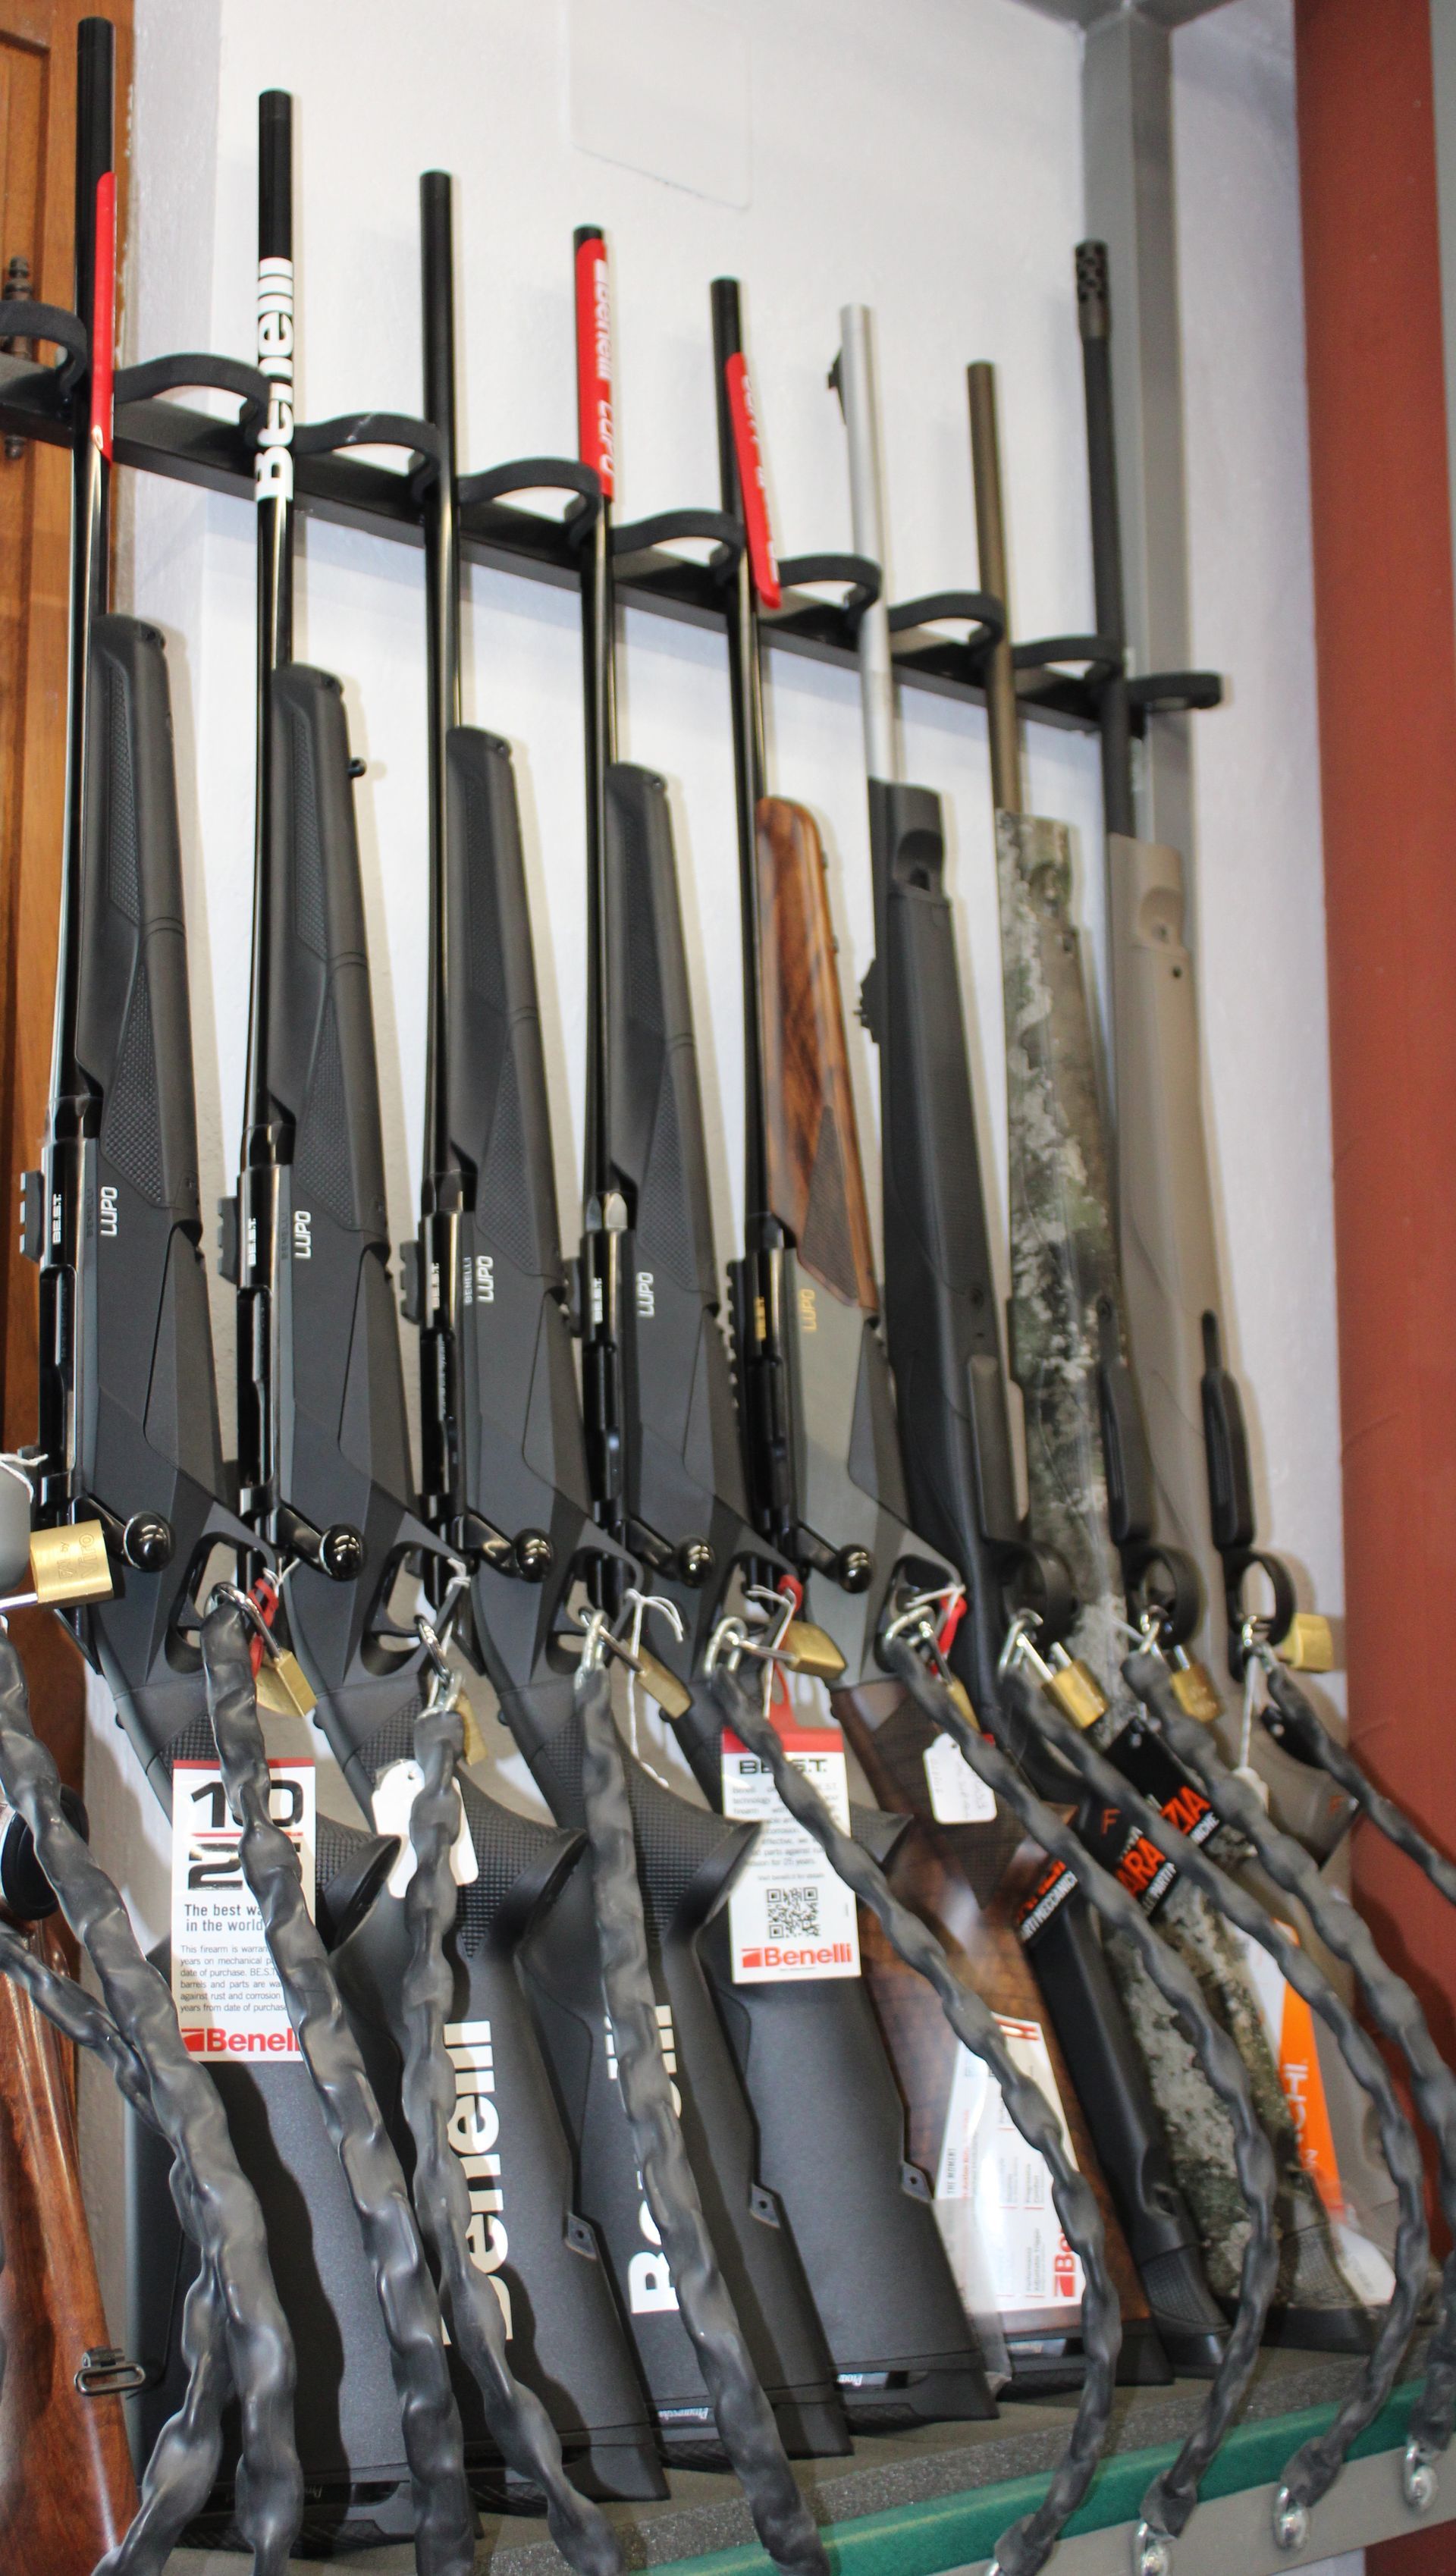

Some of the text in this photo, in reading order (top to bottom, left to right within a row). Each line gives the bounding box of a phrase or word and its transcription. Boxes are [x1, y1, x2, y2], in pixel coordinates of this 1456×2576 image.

[100, 1186, 118, 1237] LUPO
[294, 1210, 312, 1260] LUPO
[463, 1256, 472, 1306] BENELLI
[476, 1255, 494, 1303] LUPO
[636, 1272, 654, 1318] LUPO
[799, 1288, 817, 1332] LUPO
[188, 1843, 301, 1890] 2
[184, 1904, 207, 1916] The
[214, 1904, 240, 1916] best
[187, 1919, 263, 1931] in the world
[181, 1945, 197, 1953] This
[201, 1945, 228, 1953] firearm
[764, 1944, 853, 1966] Benelli
[210, 1969, 247, 1979] purchase.
[230, 1981, 249, 1990] parts
[180, 1993, 208, 2001] against
[180, 2005, 201, 2013] years
[207, 2028, 300, 2052] Benel
[442, 2021, 513, 2345] enelli
